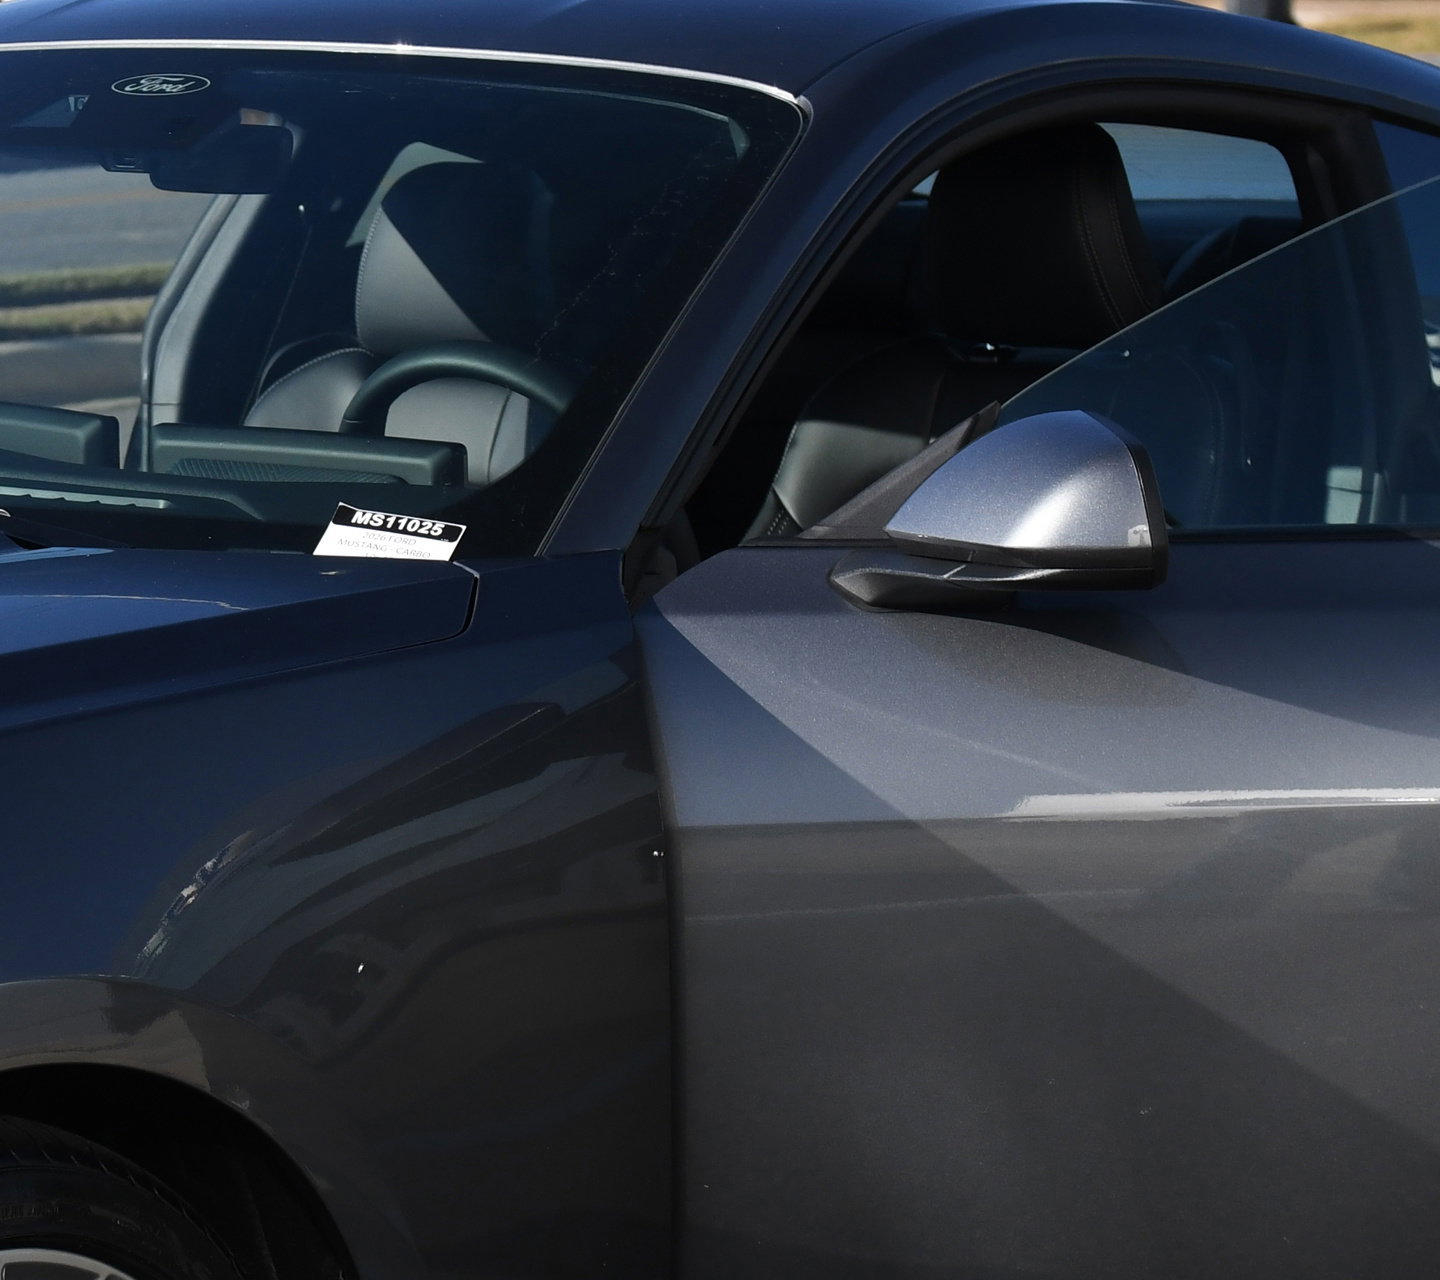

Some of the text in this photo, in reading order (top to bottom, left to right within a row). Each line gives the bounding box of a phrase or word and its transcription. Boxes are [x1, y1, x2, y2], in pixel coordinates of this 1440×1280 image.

[123, 75, 197, 93] Ford
[351, 510, 445, 537] MS11025
[337, 538, 388, 552] MUSTANG
[388, 535, 417, 546] FORD
